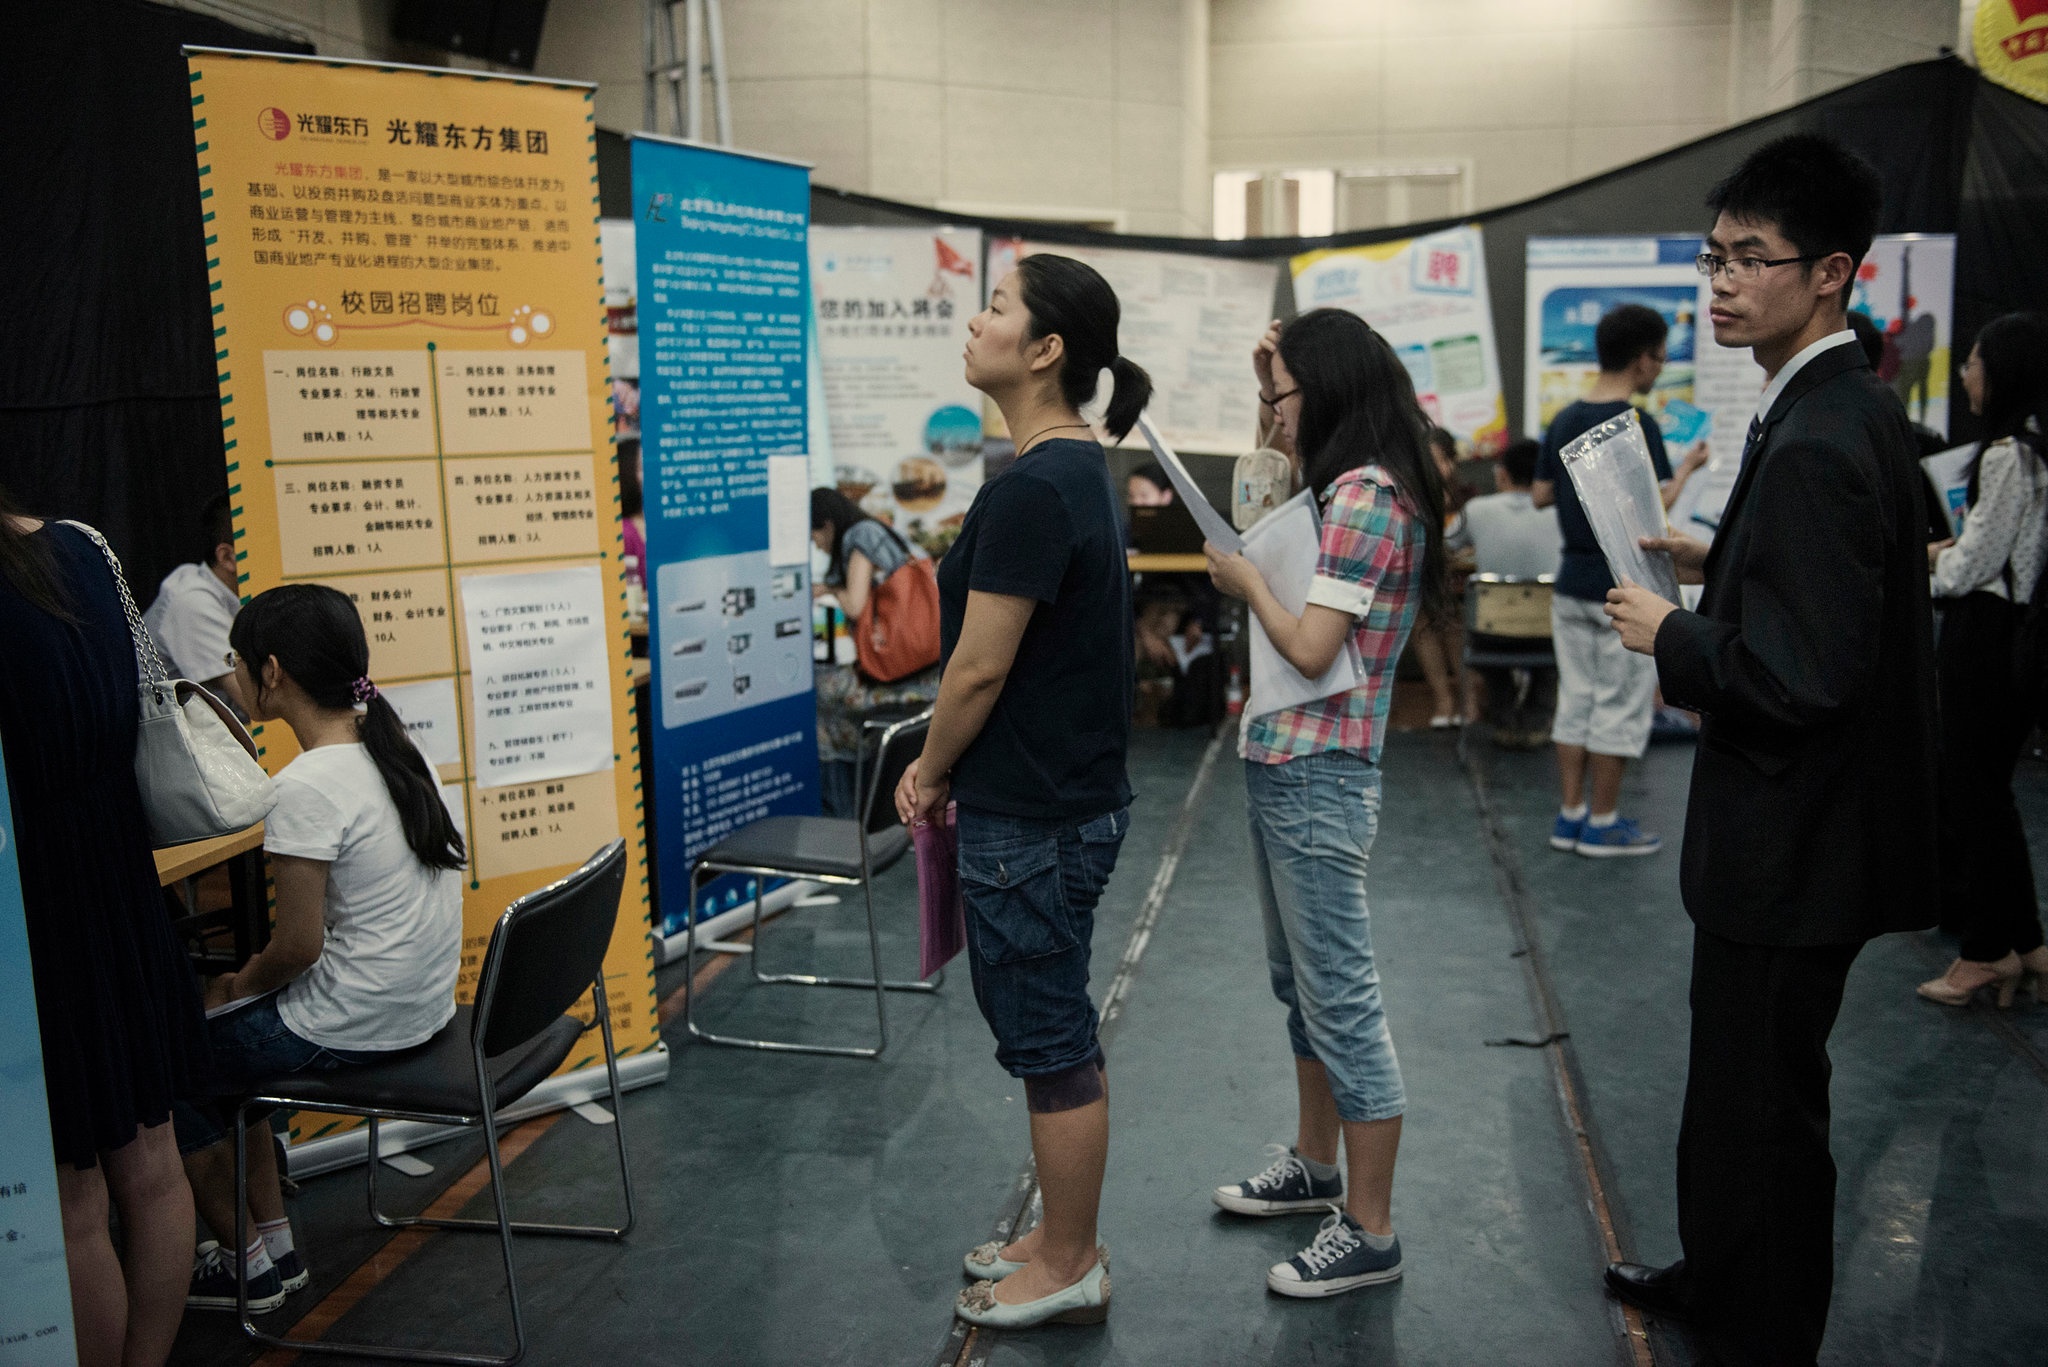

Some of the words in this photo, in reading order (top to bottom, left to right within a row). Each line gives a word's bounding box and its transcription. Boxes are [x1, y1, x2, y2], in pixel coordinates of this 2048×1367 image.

[297, 113, 369, 138] 光耀东方
[386, 118, 549, 155] 光耀东方集团
[1427, 249, 1460, 287] 聘
[341, 289, 501, 318] 校园招聘岗位
[820, 298, 954, 319] 您的加入将会
[356, 408, 420, 420] 理等相关专业
[374, 631, 397, 643] 10人
